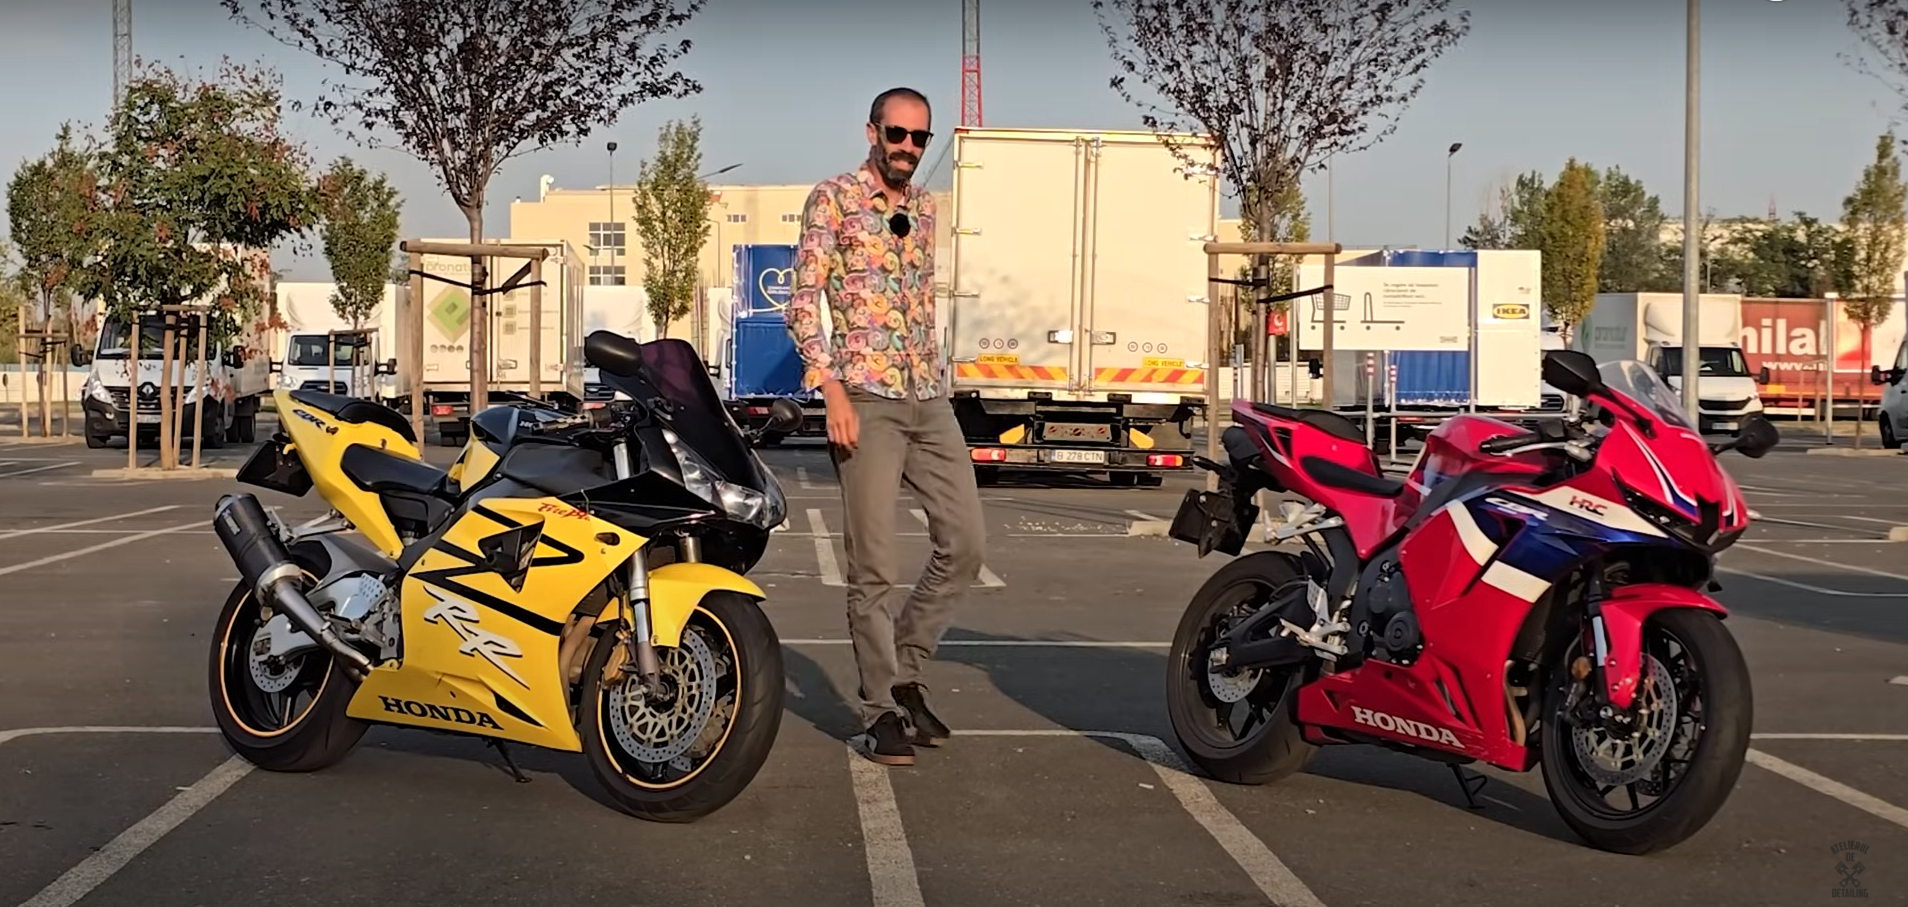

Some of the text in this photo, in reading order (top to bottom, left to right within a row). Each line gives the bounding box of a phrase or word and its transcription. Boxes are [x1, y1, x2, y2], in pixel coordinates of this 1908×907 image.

[1496, 307, 1527, 316] IKEA
[979, 355, 1018, 364] LONG VEHICLE
[1056, 451, 1064, 460] B
[1568, 494, 1608, 517] HRC
[378, 695, 505, 731] HONDA
[1350, 705, 1466, 749] HONDA
